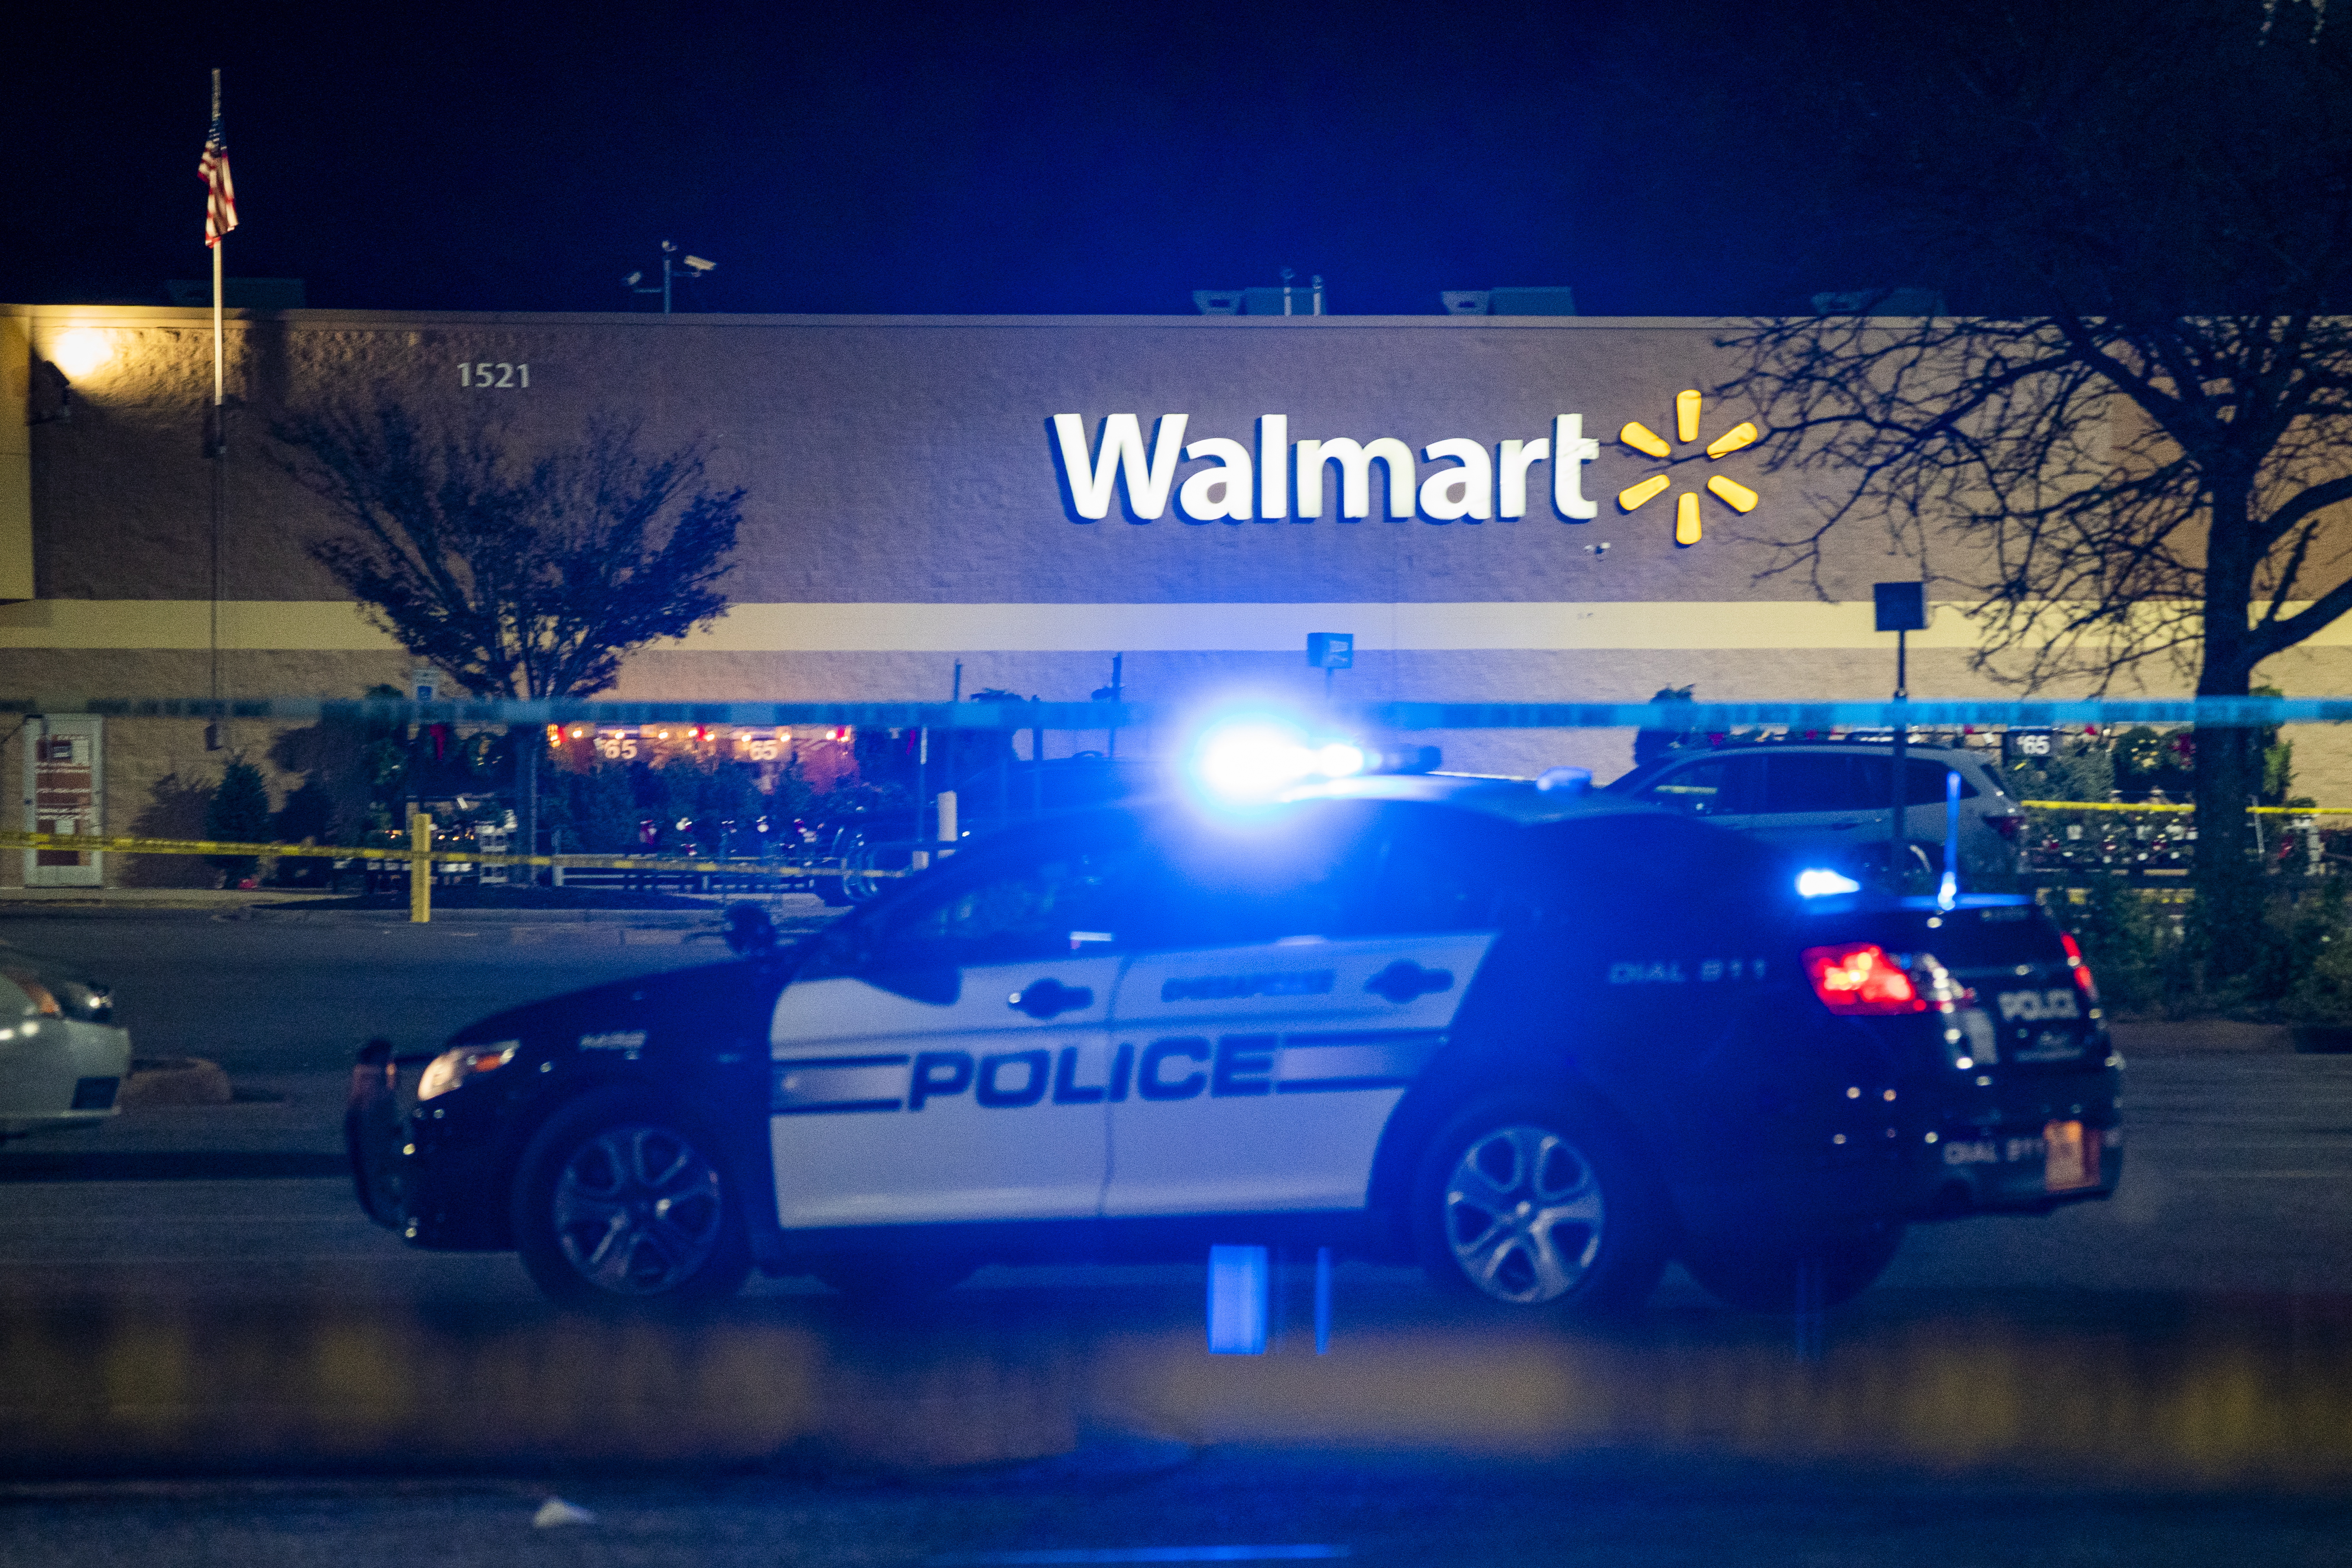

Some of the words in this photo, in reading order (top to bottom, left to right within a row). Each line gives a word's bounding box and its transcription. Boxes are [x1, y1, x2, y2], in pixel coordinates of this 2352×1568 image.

[456, 362, 529, 388] 1521
[1052, 413, 1599, 521] Walmart
[908, 1035, 1275, 1112] POLICE
